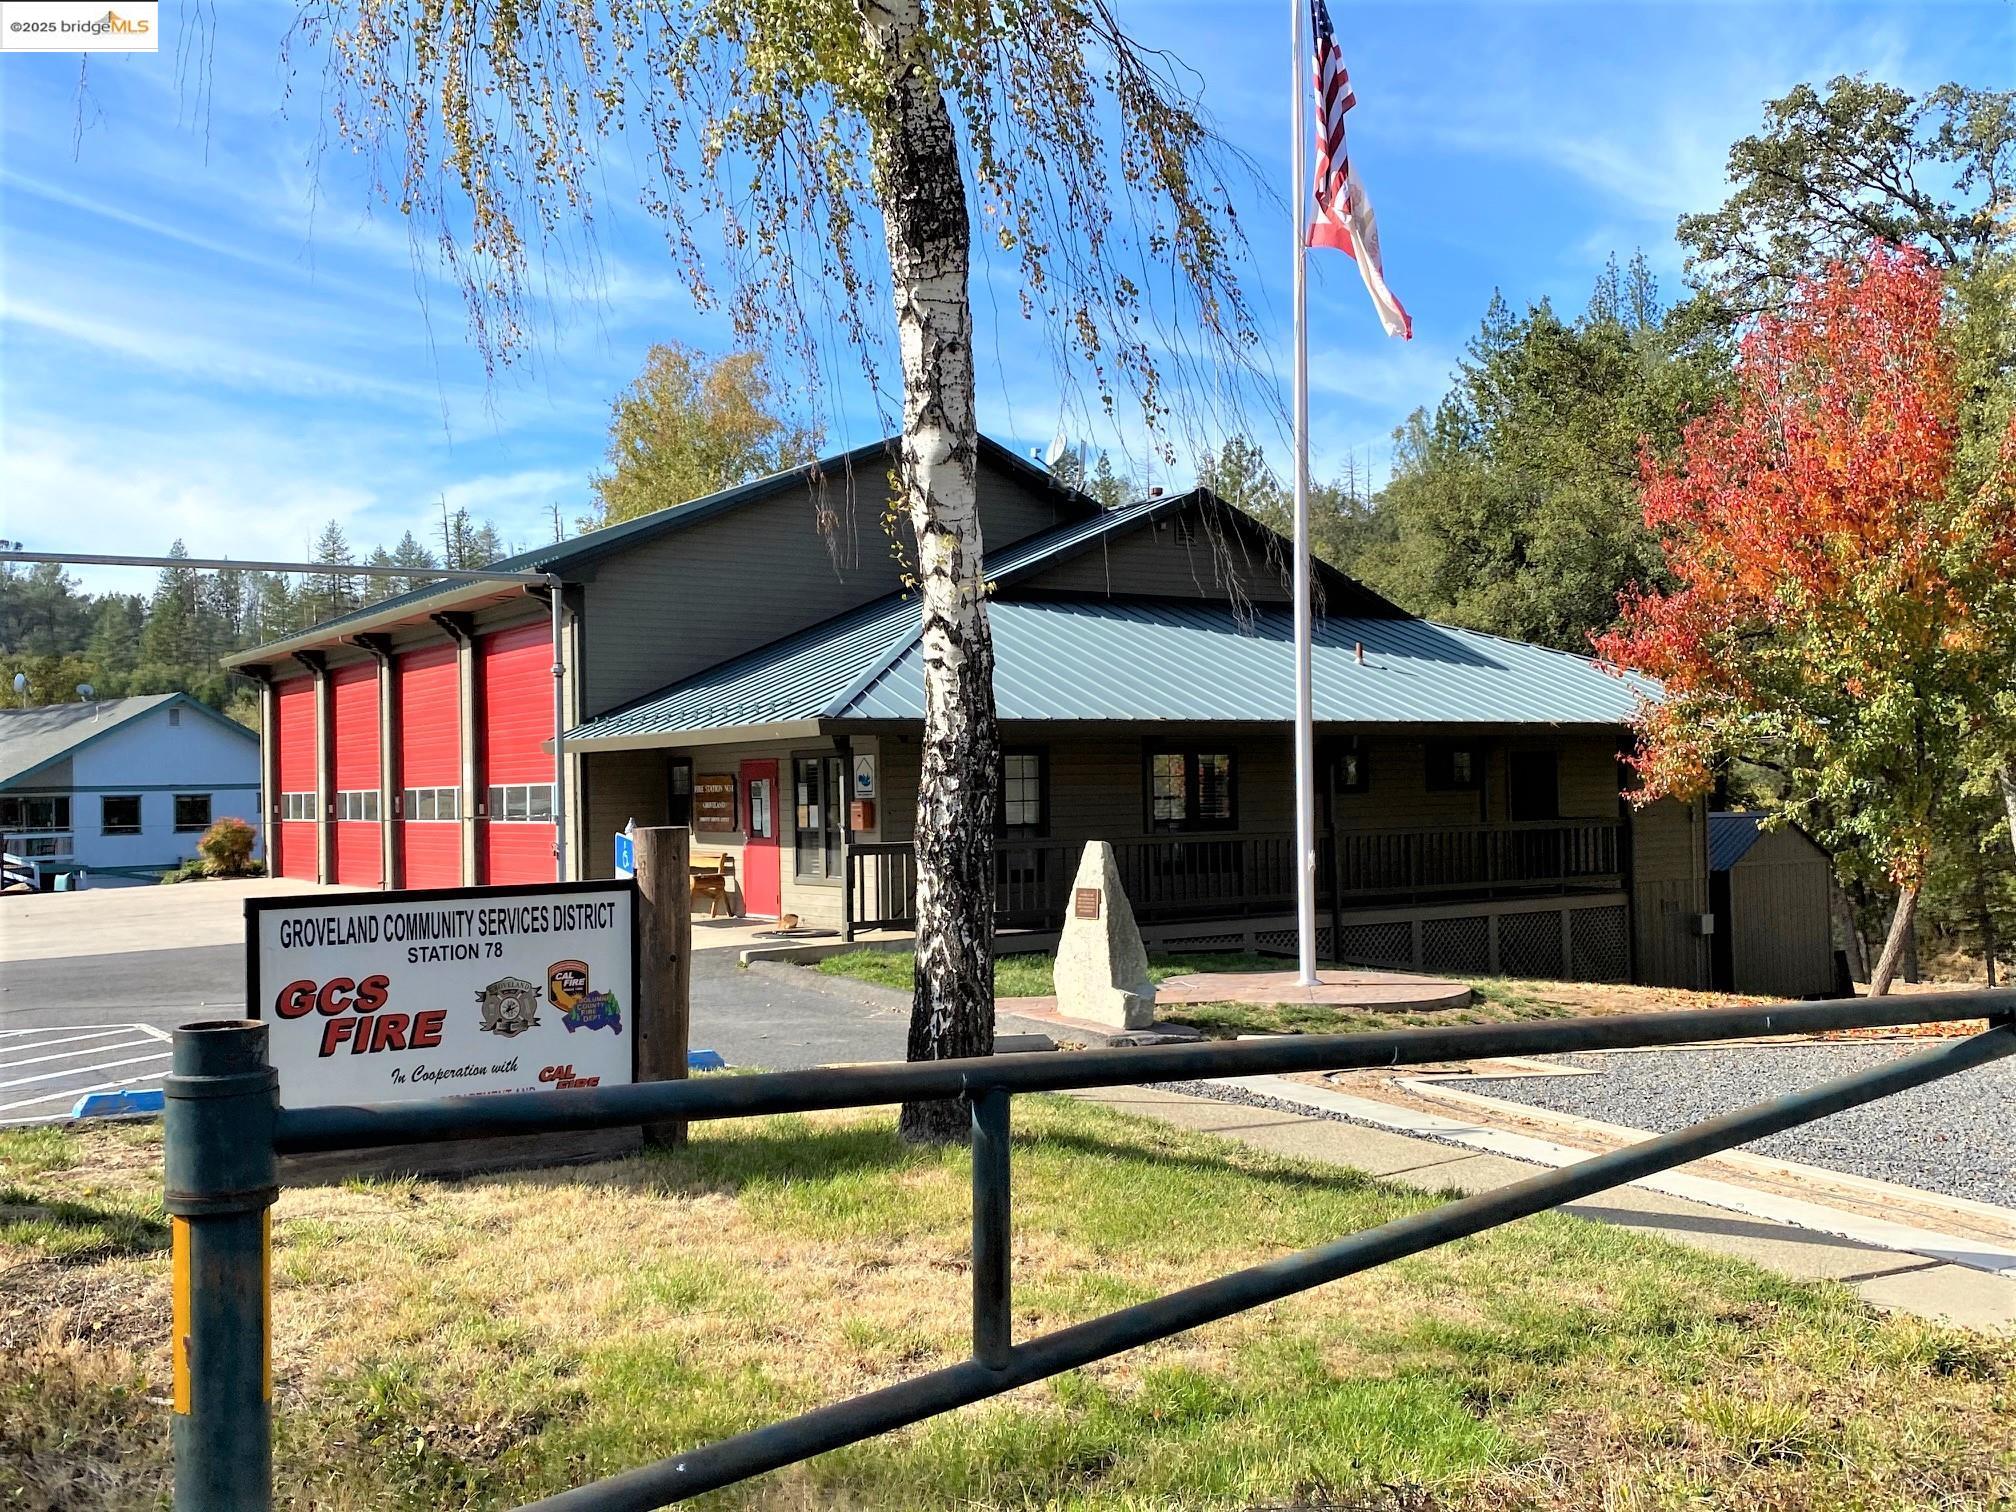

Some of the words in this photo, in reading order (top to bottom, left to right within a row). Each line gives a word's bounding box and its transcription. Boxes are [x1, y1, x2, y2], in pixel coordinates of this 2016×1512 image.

[280, 915, 379, 949] GROVELAND
[383, 909, 474, 942] COMMUNITY
[478, 905, 549, 936] SERVICES
[553, 902, 615, 932] DISTRICT
[407, 943, 479, 964] STATION
[485, 942, 503, 958] 78
[555, 971, 574, 981] CAL
[563, 978, 586, 987] FIRE
[275, 974, 390, 1020] GCS
[318, 1010, 448, 1058] FIRE
[391, 1068, 407, 1085] In
[411, 1064, 488, 1085] Cooperation
[491, 1056, 519, 1073] with
[538, 1064, 576, 1082] CAL
